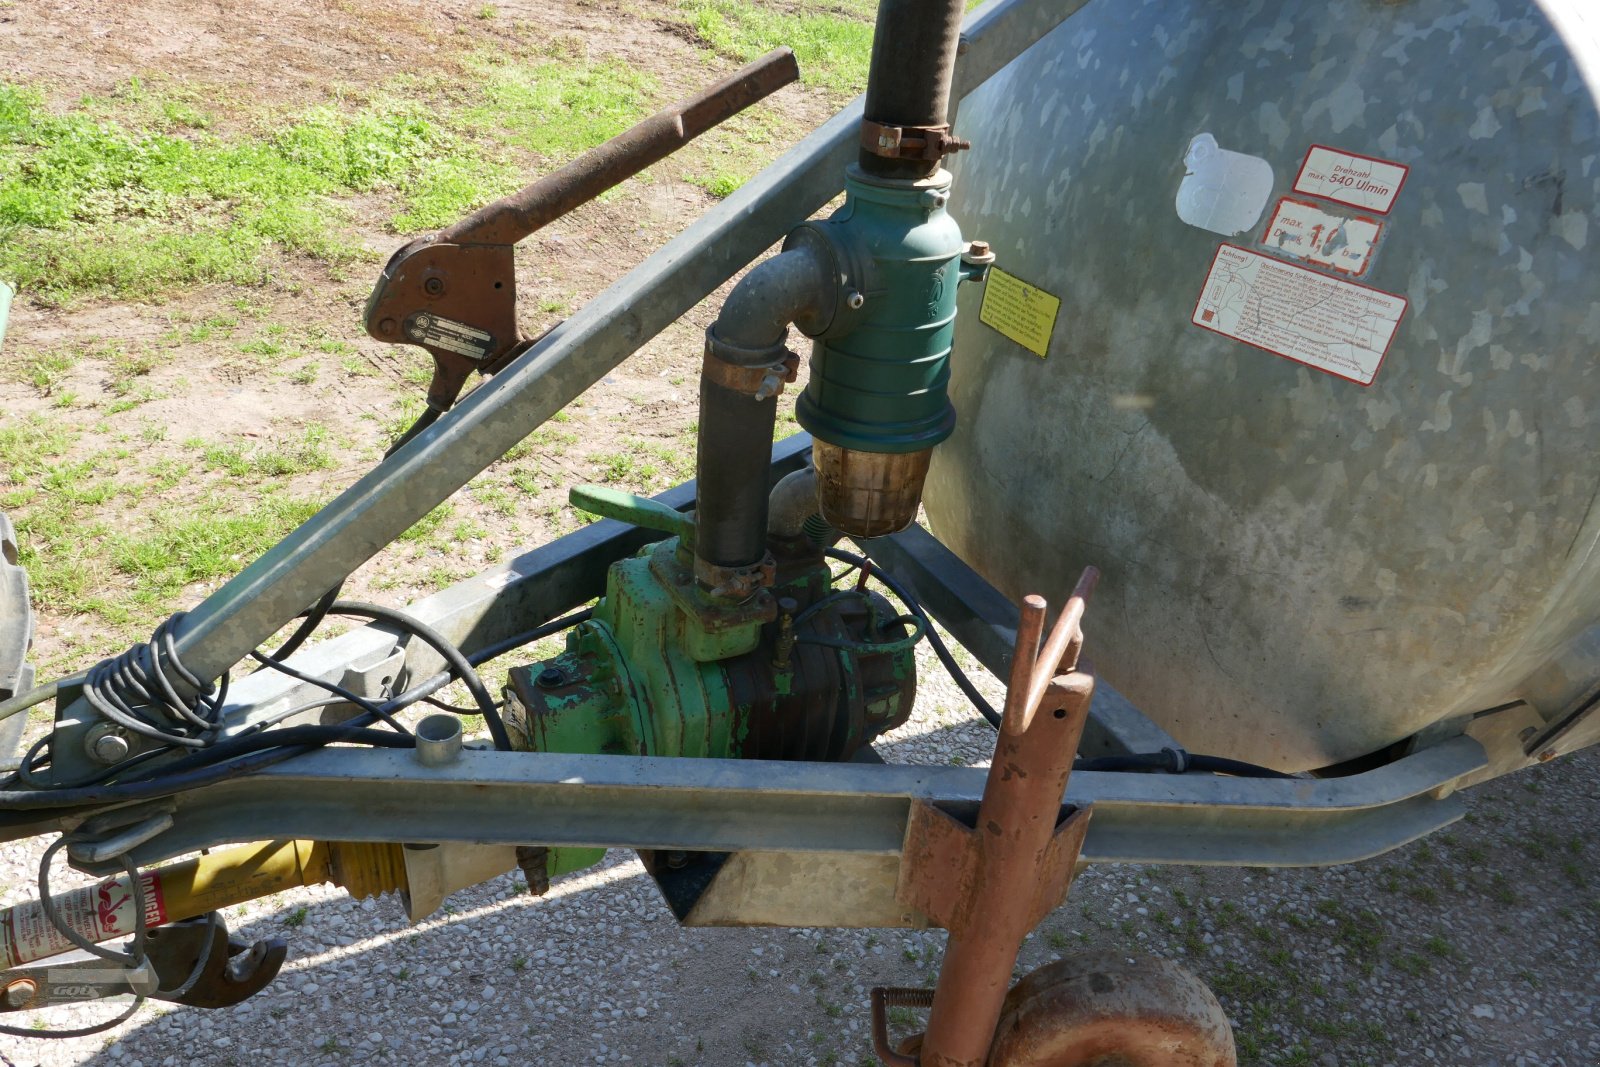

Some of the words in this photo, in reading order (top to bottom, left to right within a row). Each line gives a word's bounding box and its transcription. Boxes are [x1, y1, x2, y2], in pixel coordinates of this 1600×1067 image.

[1333, 164, 1371, 179] Drehzahl
[1307, 170, 1326, 182] max.
[1328, 173, 1353, 187] 540
[1356, 179, 1389, 196] U/min
[1279, 215, 1303, 229] max.
[1221, 250, 1248, 263] Achtung!
[1354, 292, 1392, 306] Kompressors
[143, 876, 161, 925] DANGER
